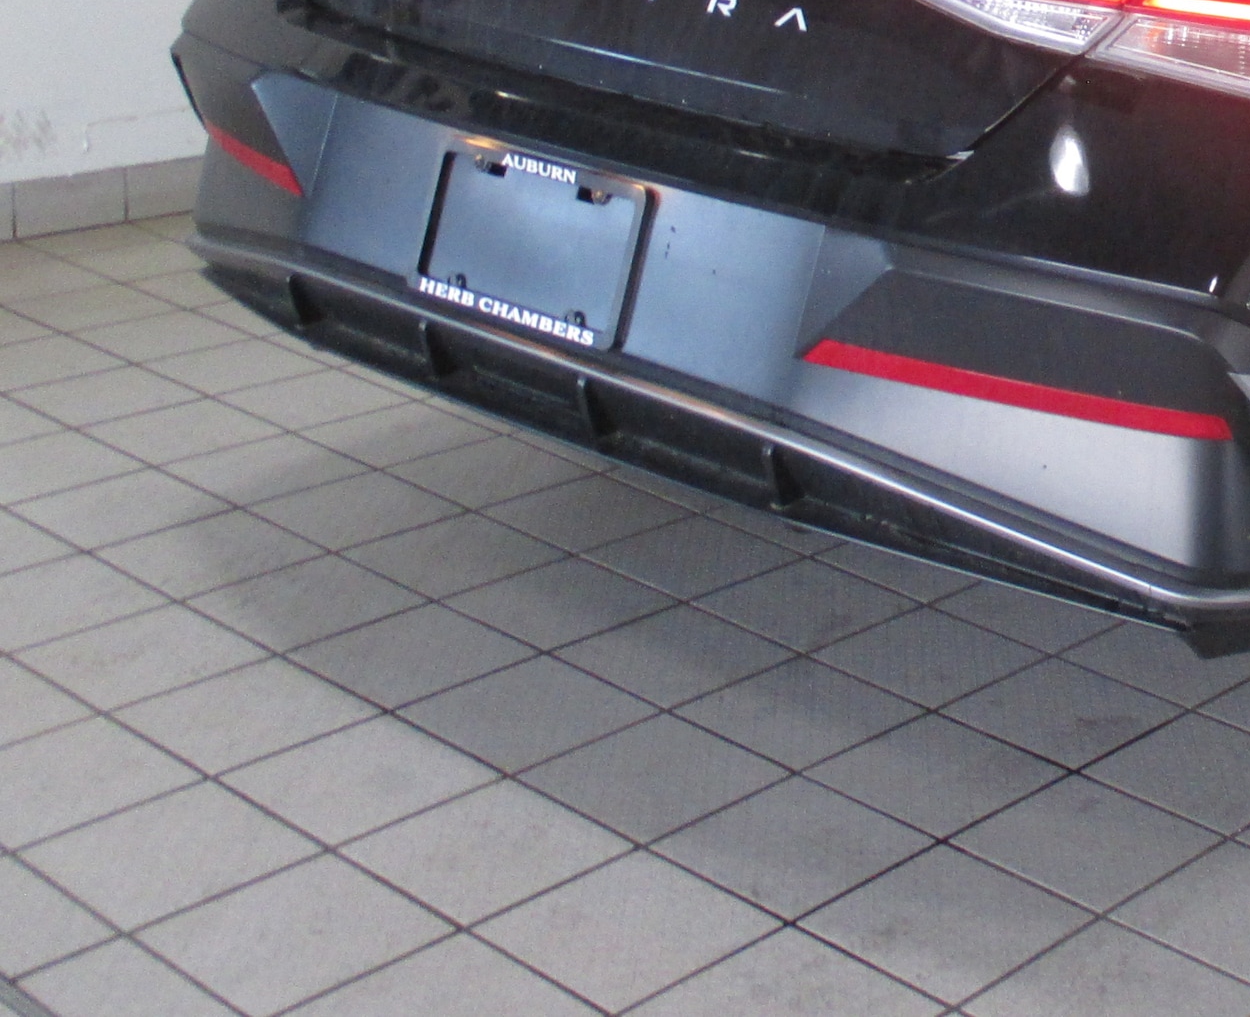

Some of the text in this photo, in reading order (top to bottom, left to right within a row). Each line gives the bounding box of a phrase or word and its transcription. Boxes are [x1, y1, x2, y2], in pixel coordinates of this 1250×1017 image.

[501, 153, 577, 184] AUBURN
[419, 277, 595, 346] HERB CHAMBERS
